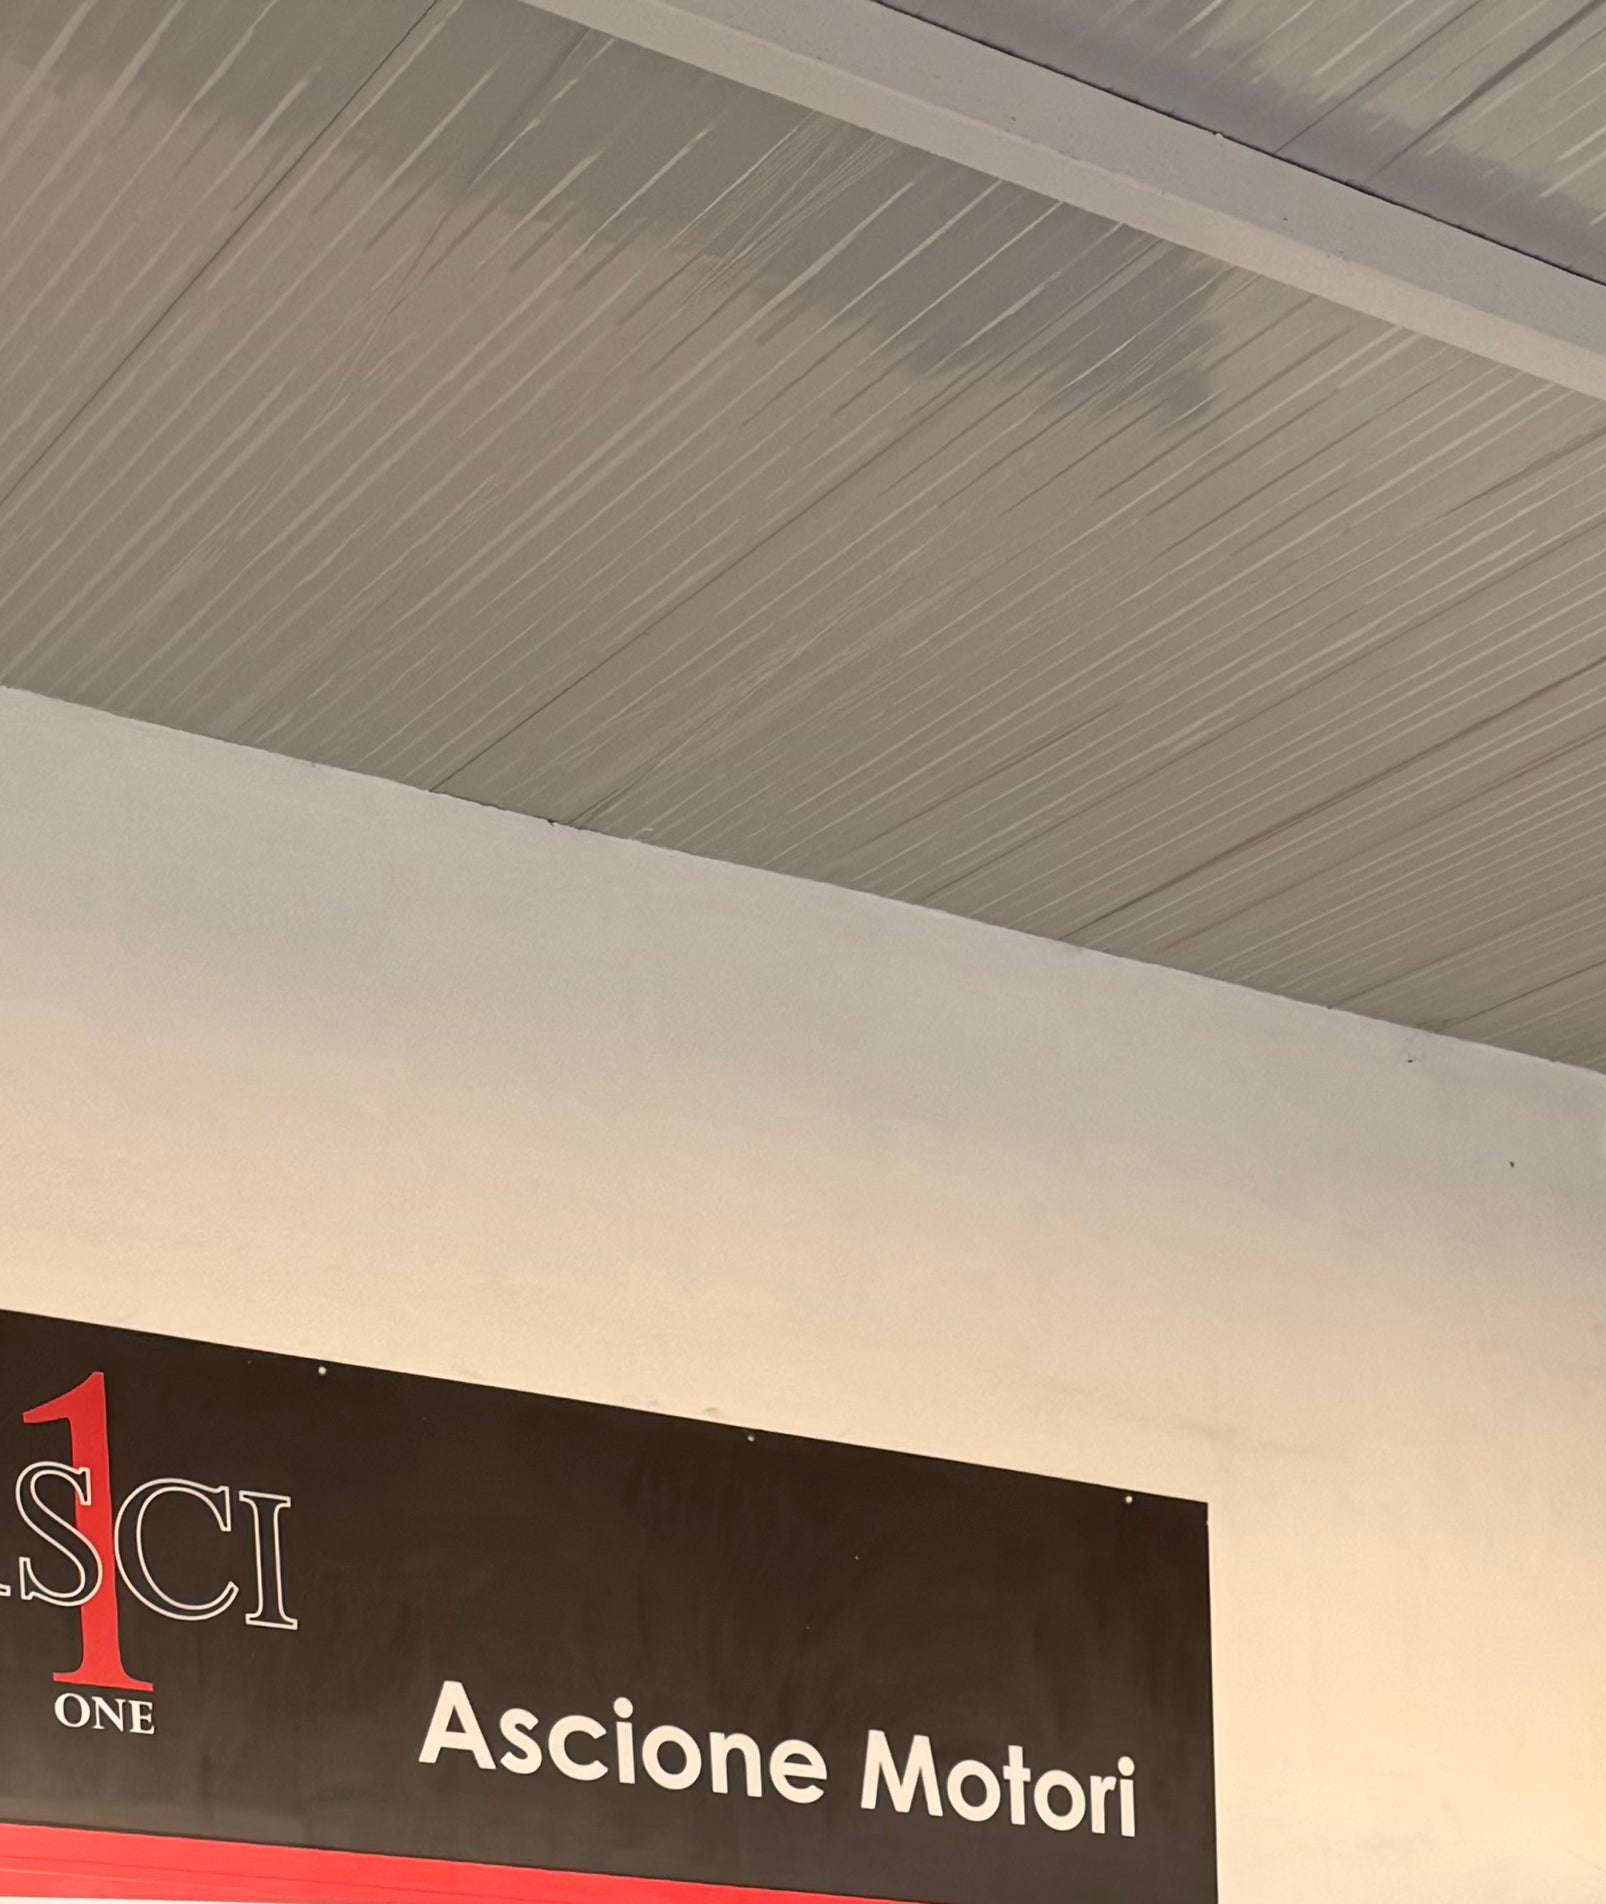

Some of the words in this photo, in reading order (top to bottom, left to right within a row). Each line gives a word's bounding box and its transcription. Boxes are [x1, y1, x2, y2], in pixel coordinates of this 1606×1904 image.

[0, 1461, 298, 1630] SCI
[54, 1692, 155, 1735] ONE
[418, 1680, 828, 1804] Ascione
[861, 1729, 1137, 1838] Motori
